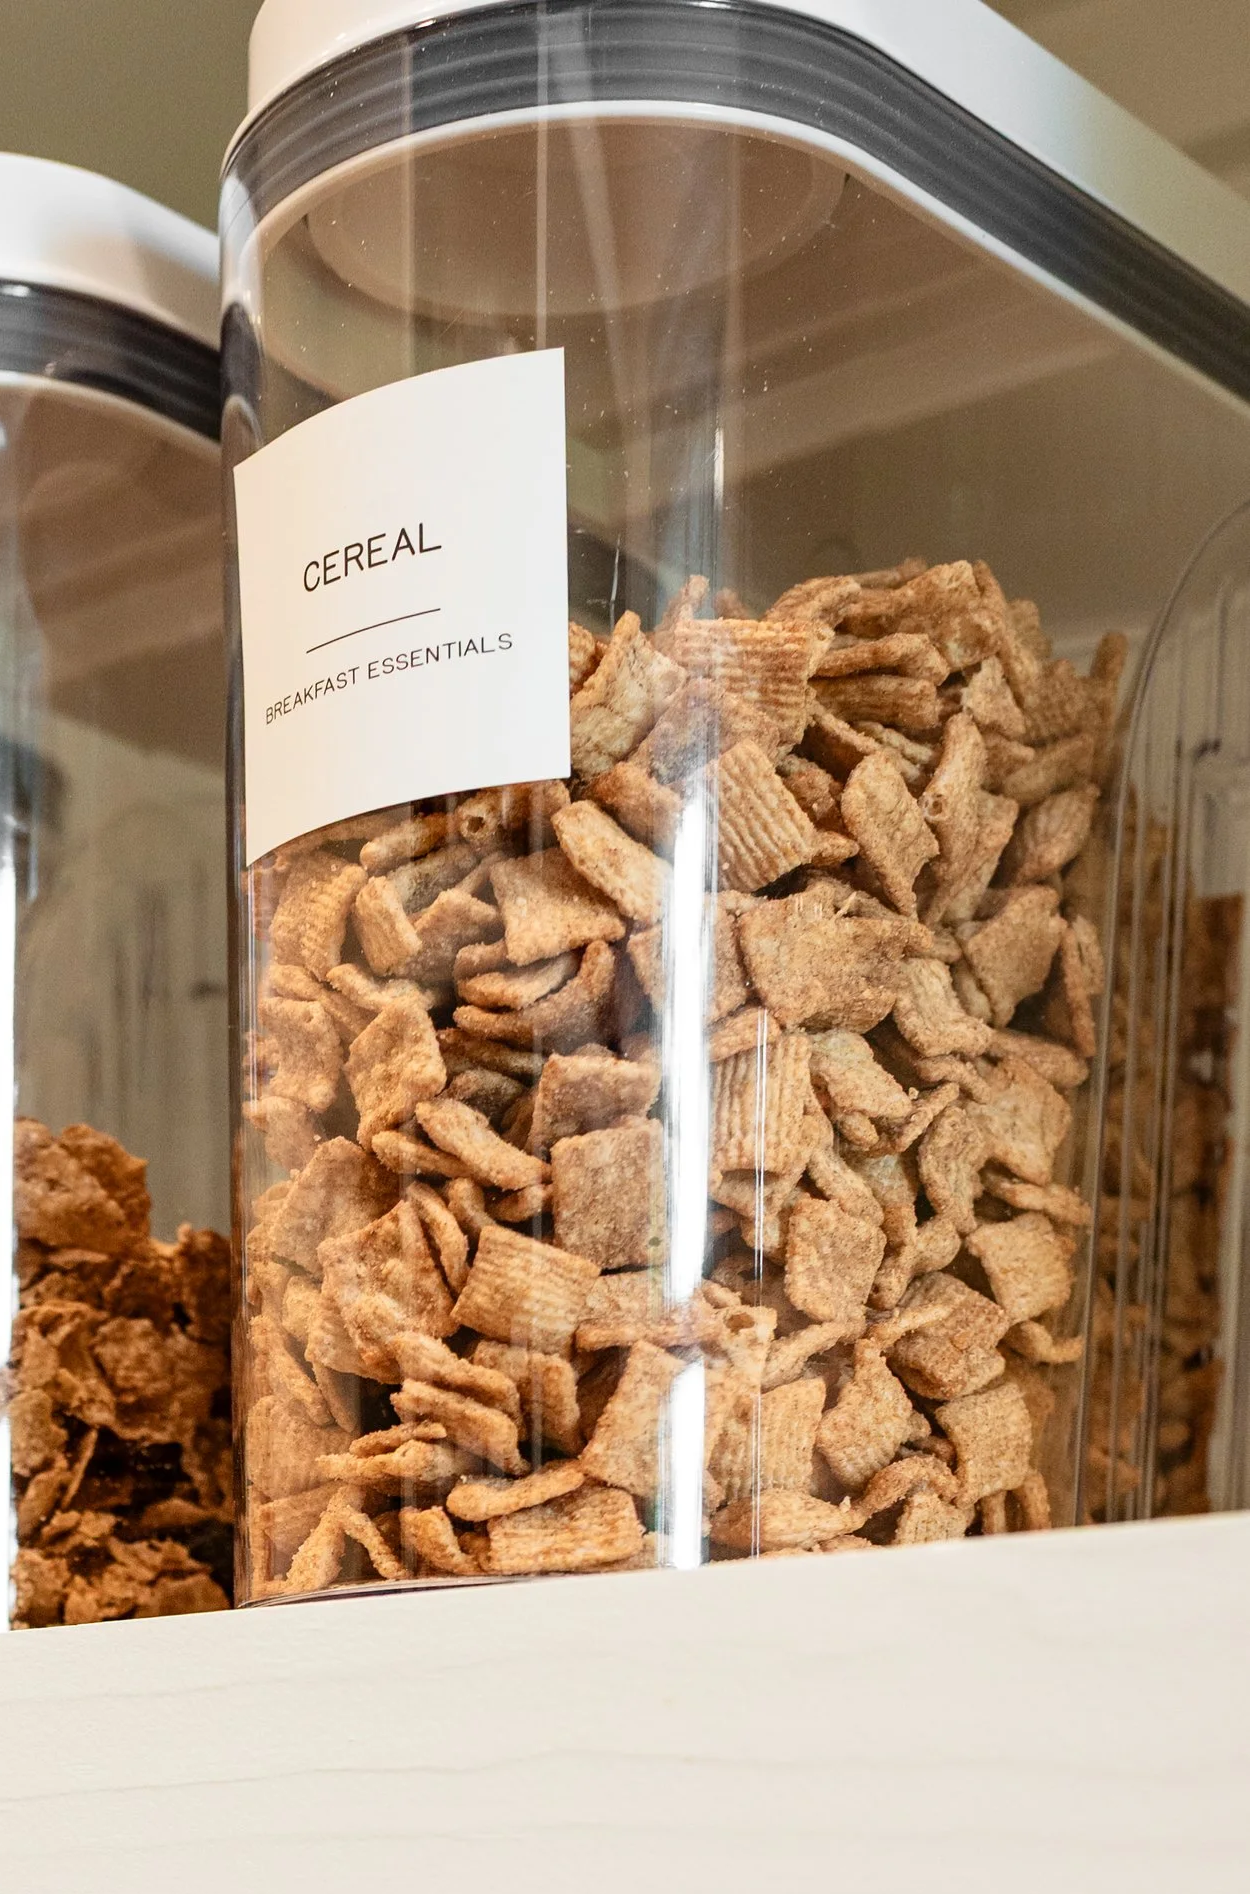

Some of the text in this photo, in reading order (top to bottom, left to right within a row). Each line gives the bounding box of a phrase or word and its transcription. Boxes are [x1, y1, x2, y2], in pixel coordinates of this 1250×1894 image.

[302, 522, 442, 592] CEREAL
[266, 632, 514, 726] BREAKFAST ESSENTIALS
